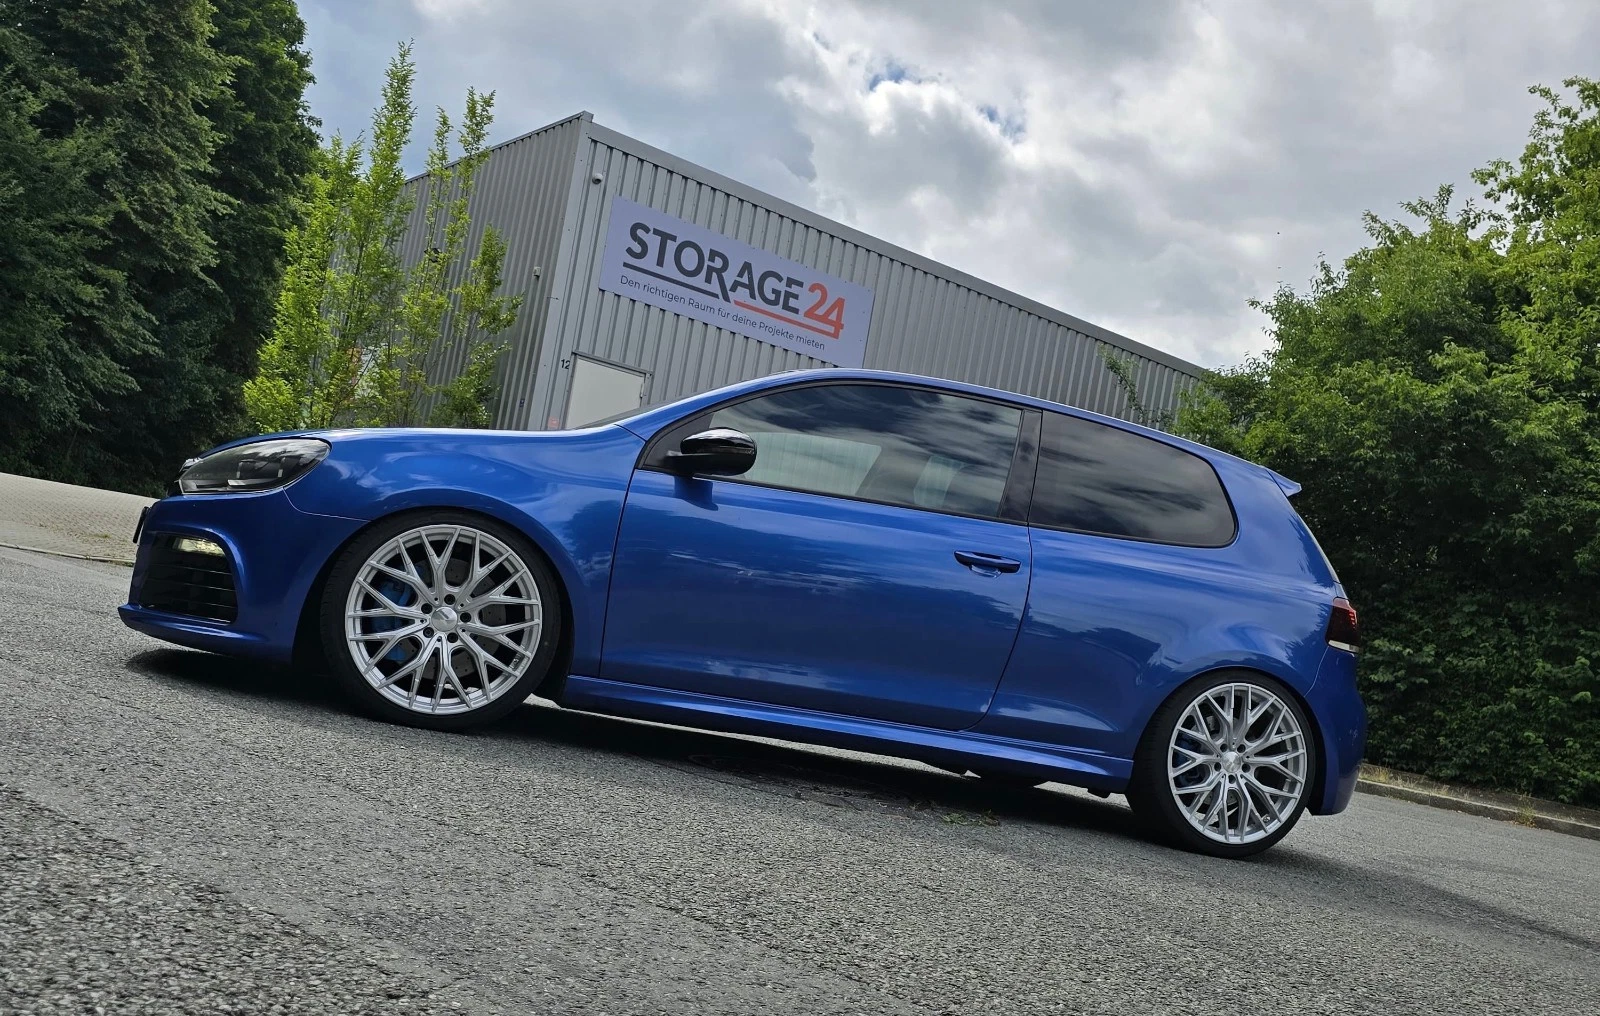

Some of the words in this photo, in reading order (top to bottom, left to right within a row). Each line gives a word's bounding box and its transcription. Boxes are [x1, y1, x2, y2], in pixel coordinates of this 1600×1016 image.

[620, 275, 640, 290] Den
[643, 283, 686, 304] richtigen
[688, 298, 715, 314] Raum
[717, 307, 730, 319] für
[731, 313, 757, 328] deine
[759, 321, 795, 339] Projekte
[796, 335, 825, 351] mieten
[625, 222, 846, 337] STORAGE24
[561, 359, 570, 370] 12
